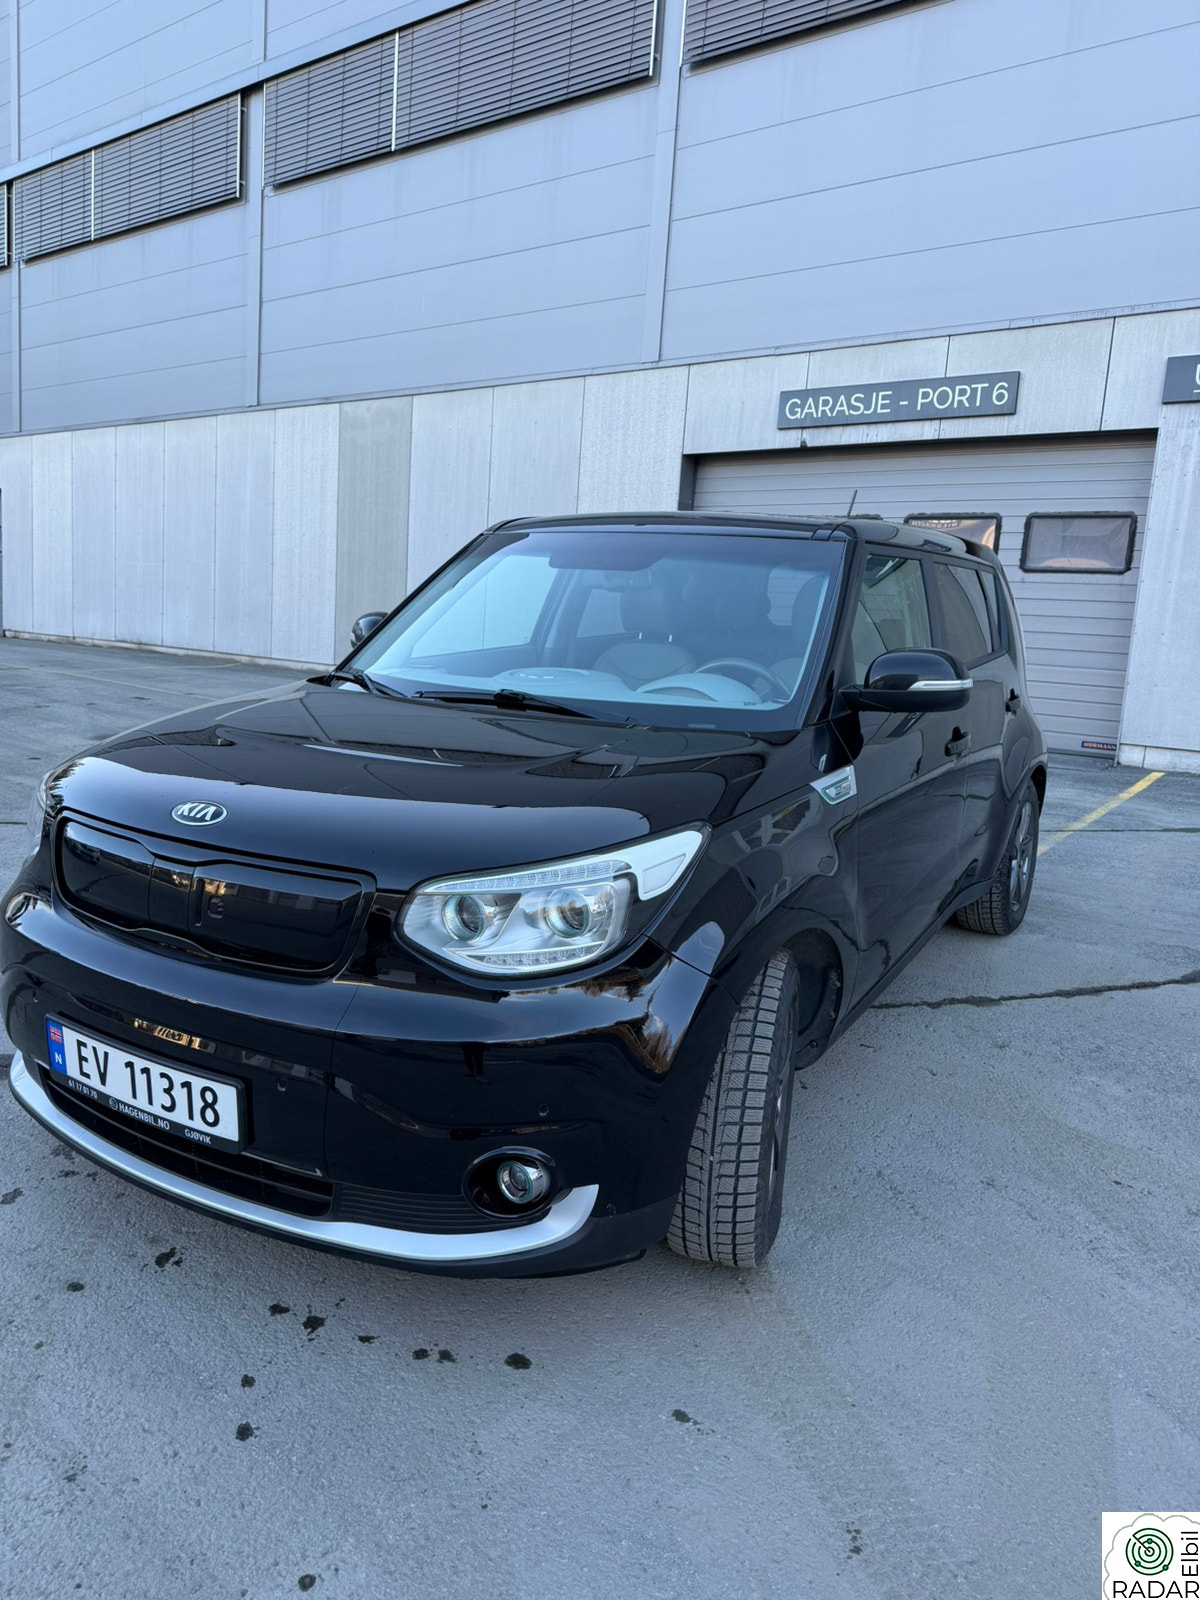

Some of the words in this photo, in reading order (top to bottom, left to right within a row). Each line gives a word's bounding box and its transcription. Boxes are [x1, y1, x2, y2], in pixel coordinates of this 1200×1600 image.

[785, 390, 892, 420] GARASJE
[917, 383, 989, 410] PORT
[992, 382, 1009, 405] 6
[177, 803, 217, 821] KIA
[54, 1052, 62, 1065] N
[76, 1039, 109, 1087] EV
[124, 1061, 220, 1128] 11318
[119, 1103, 170, 1130] HAGENBIL.NO
[184, 1128, 211, 1144] GJØVIK
